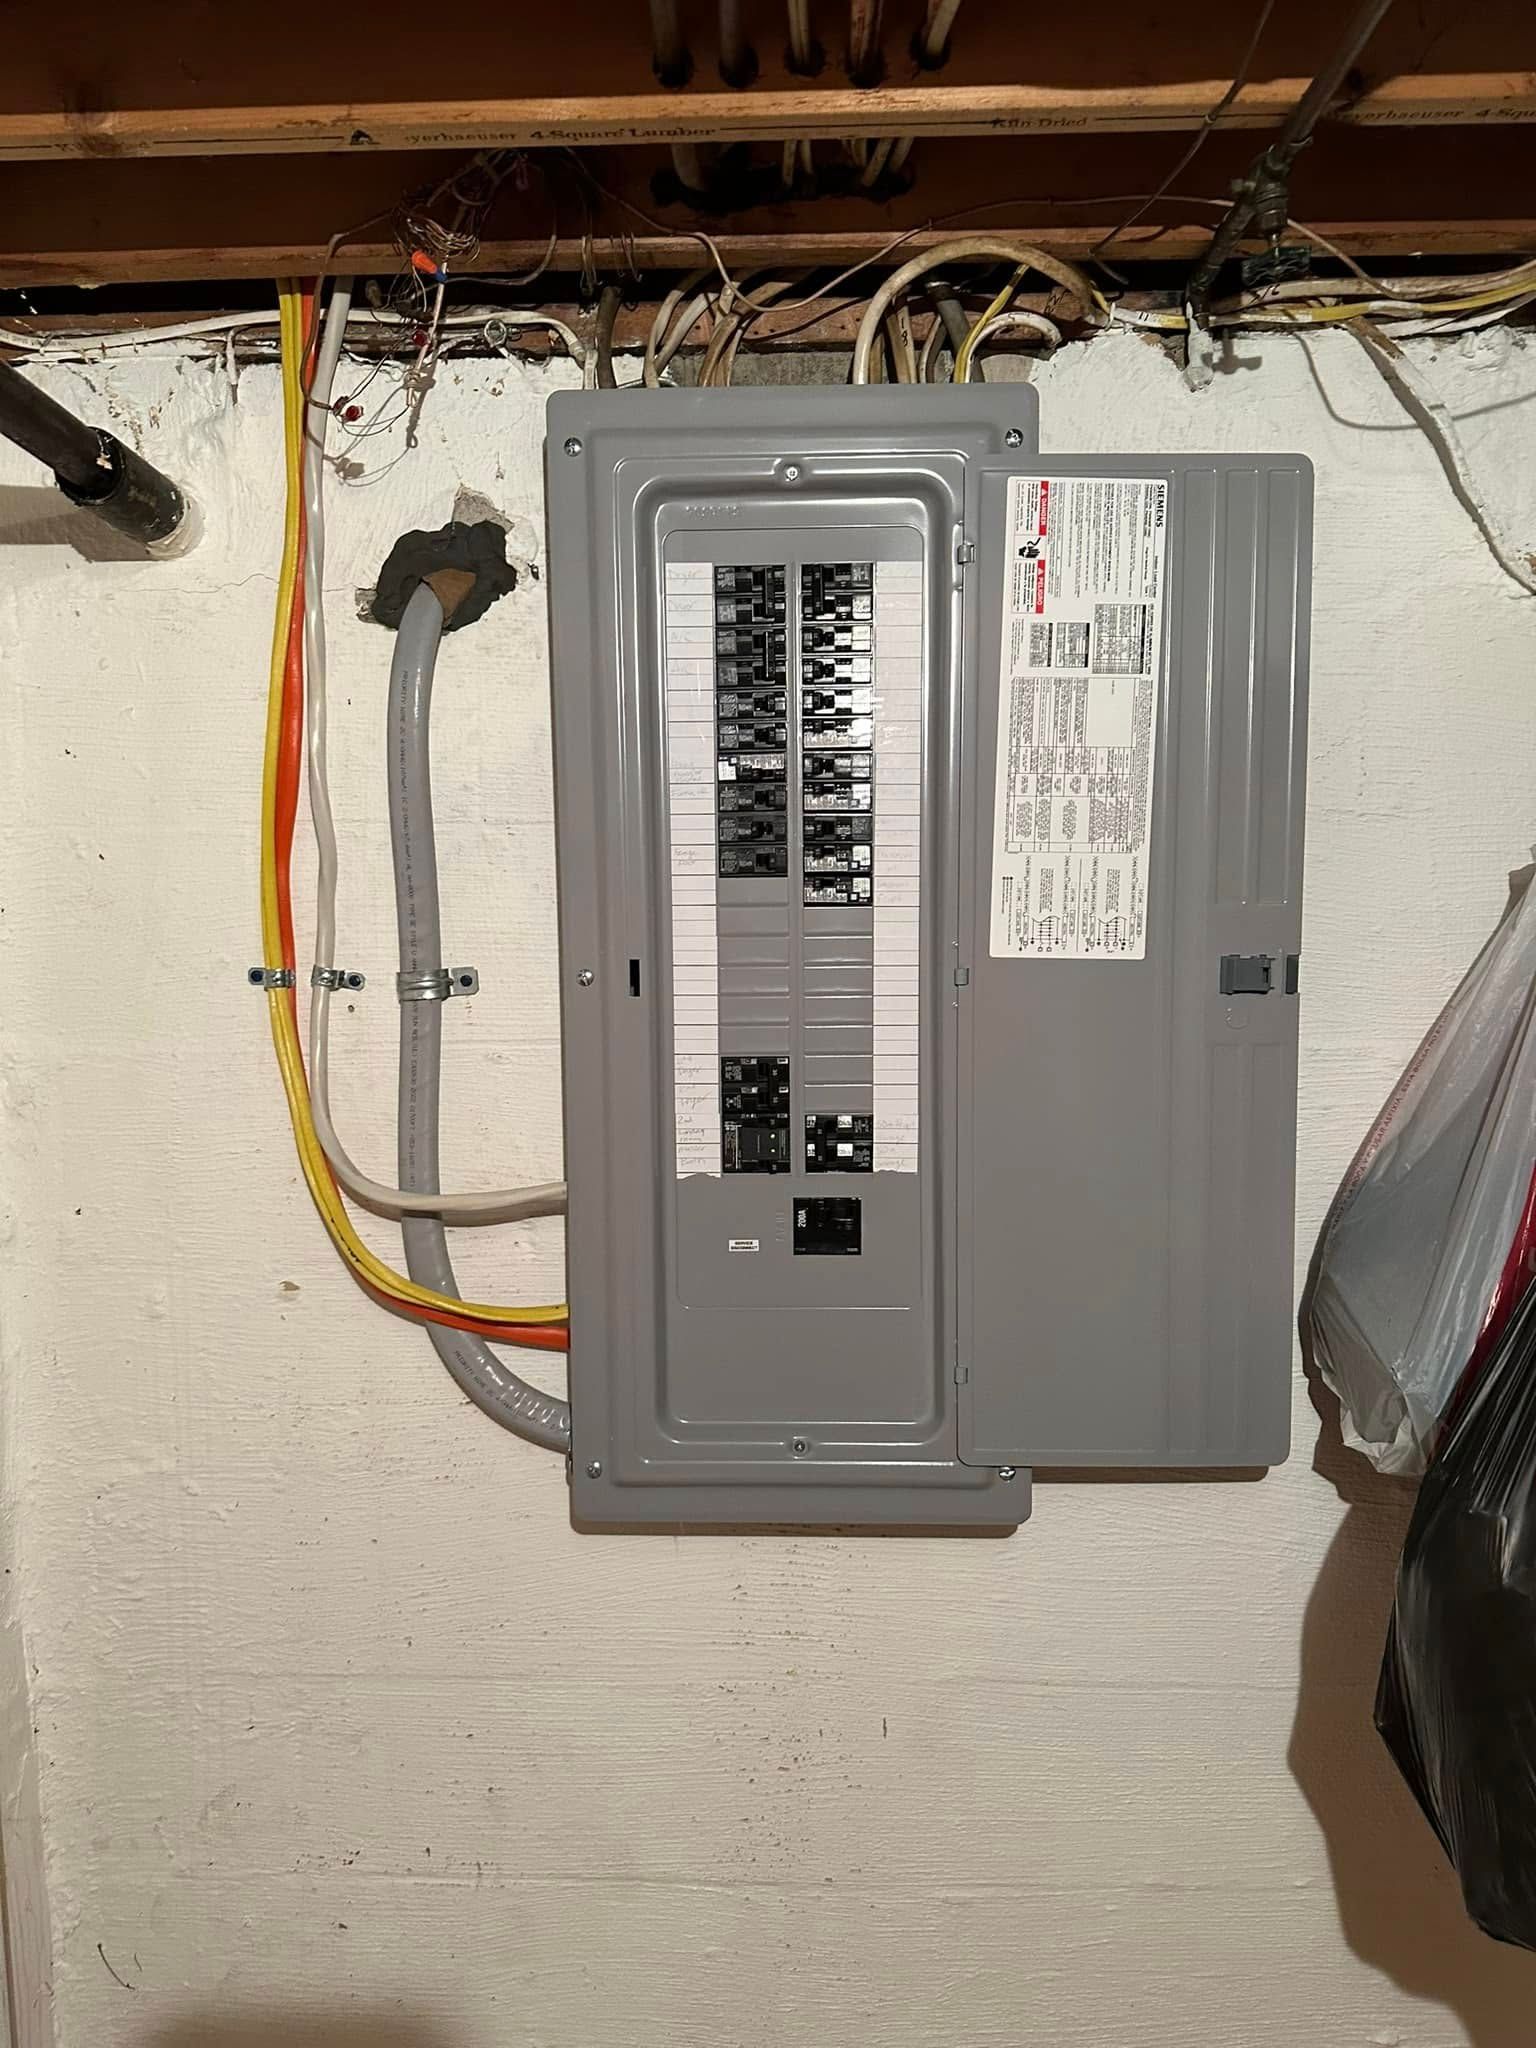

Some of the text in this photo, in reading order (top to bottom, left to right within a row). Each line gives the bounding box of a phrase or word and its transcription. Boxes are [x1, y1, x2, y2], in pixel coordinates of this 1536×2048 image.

[1039, 117, 1088, 128] Dried
[1040, 497, 1049, 525] DANGER
[1156, 484, 1165, 528] SIEMENS
[797, 1209, 807, 1228] 200A
